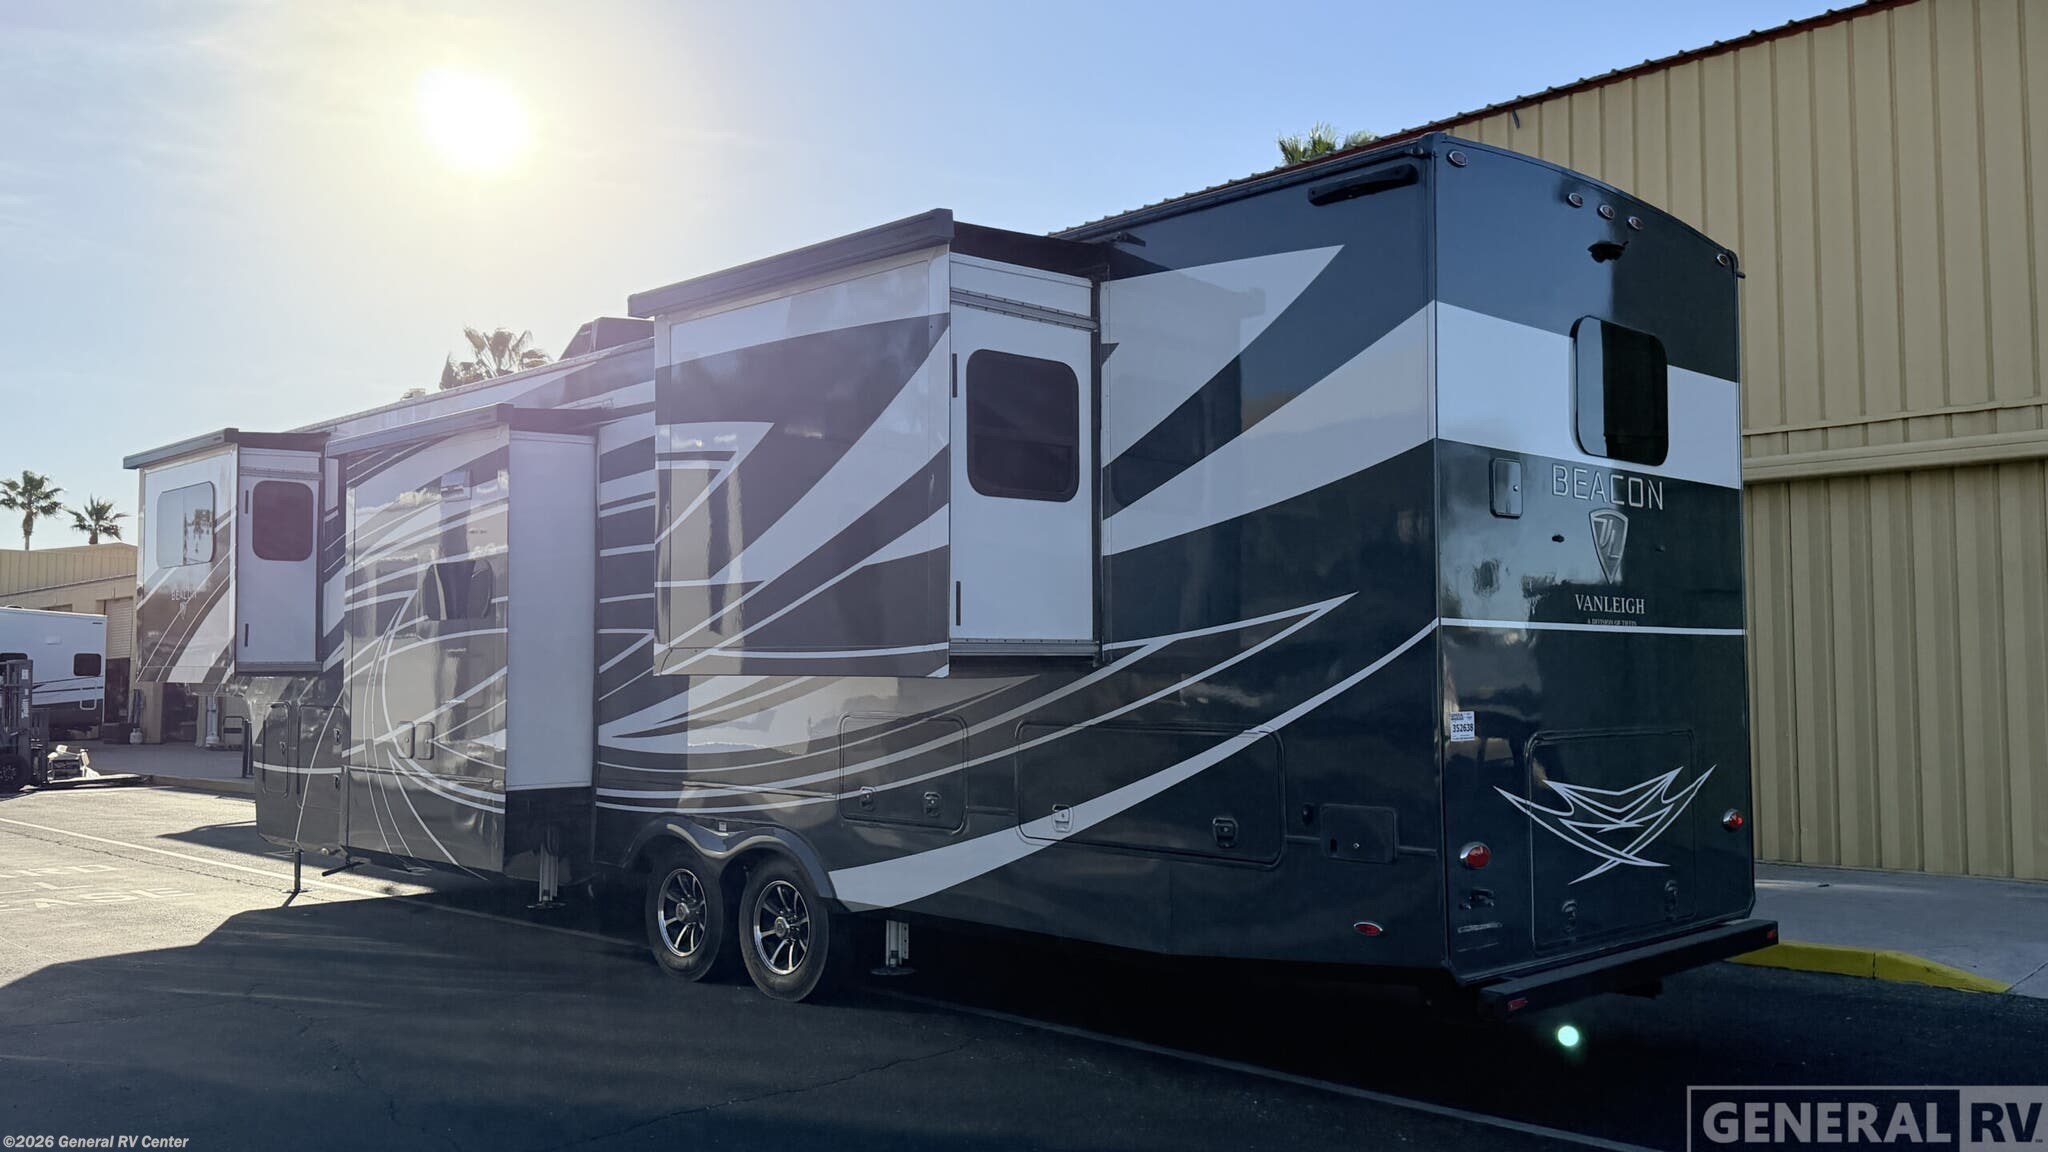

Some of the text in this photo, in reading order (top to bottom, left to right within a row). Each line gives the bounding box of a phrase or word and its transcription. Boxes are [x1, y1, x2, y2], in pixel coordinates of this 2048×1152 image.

[1552, 462, 1664, 511] BEACON
[1574, 594, 1646, 614] VANLEIGH
[1452, 723, 1474, 733] 352638
